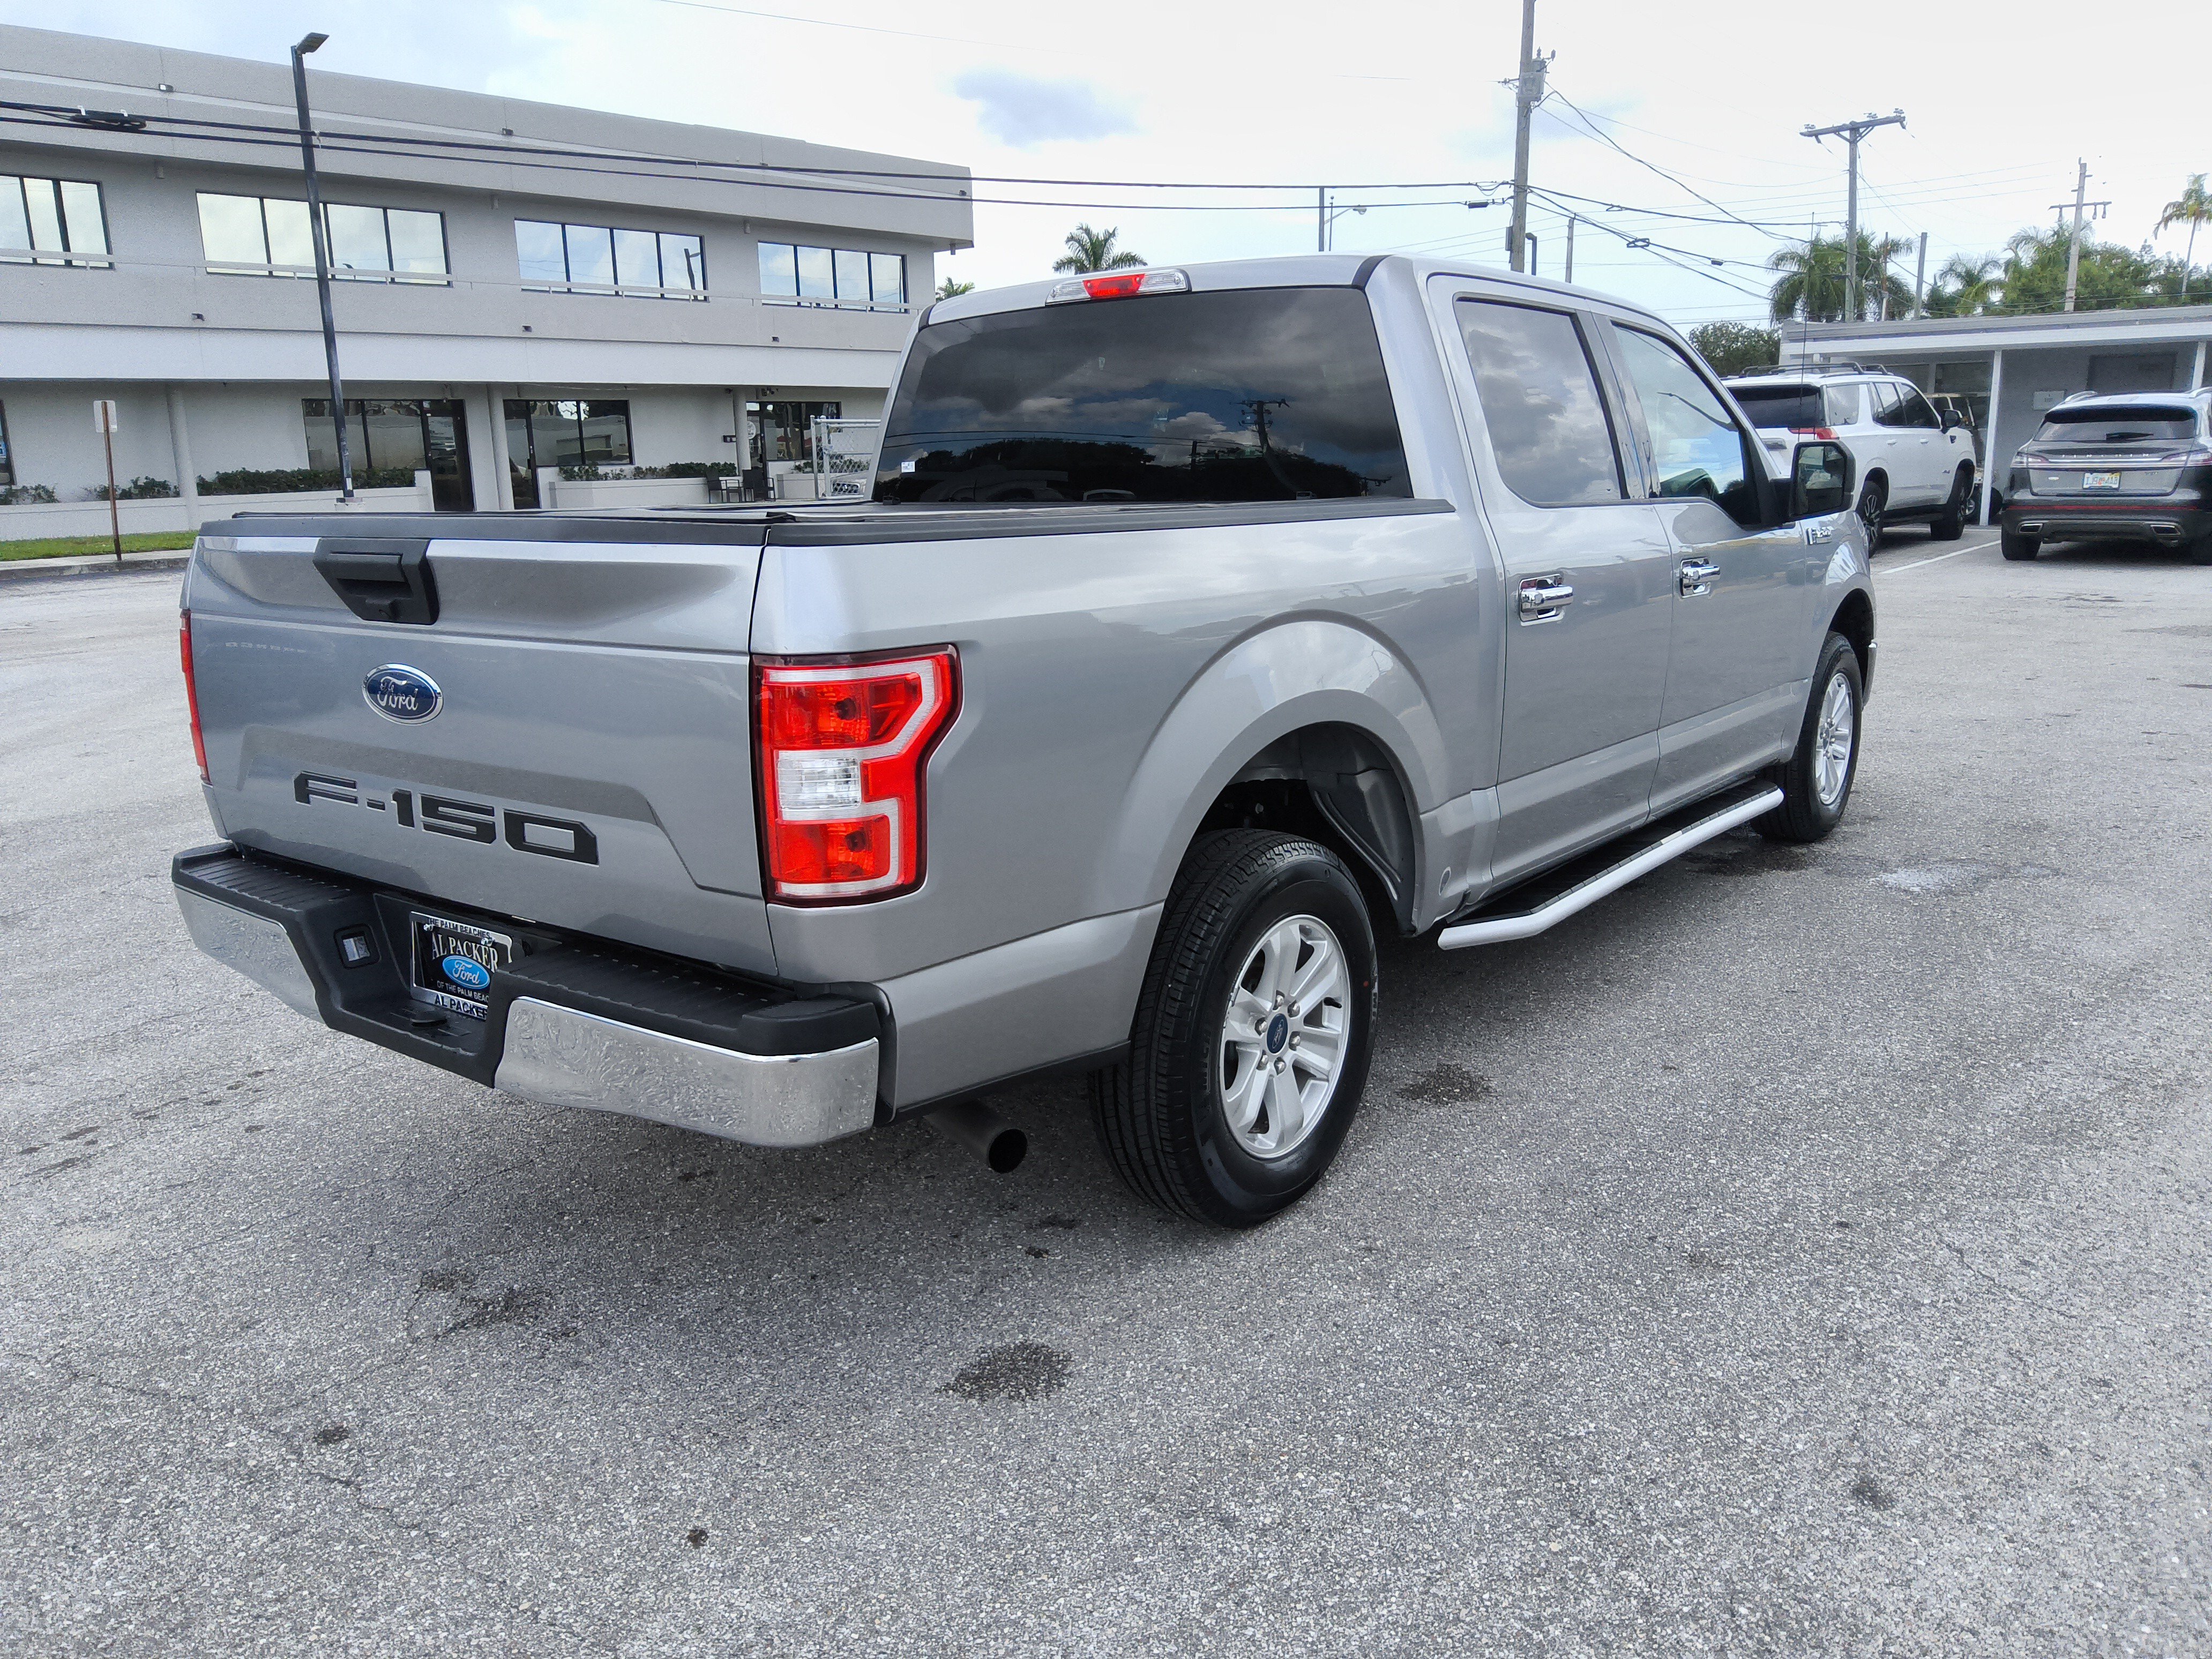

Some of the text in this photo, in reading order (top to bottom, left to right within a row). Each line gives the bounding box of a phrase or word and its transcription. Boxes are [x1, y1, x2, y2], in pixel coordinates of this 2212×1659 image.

[377, 676, 419, 711] Ford
[294, 771, 599, 867] F-150
[428, 918, 491, 939] THE PALM BEACHES
[432, 932, 498, 973] AL PACKER
[452, 960, 480, 984] Ford
[435, 993, 447, 1007] AL
[437, 980, 444, 989] OF
[445, 983, 457, 993] THE
[458, 987, 473, 998] PALM
